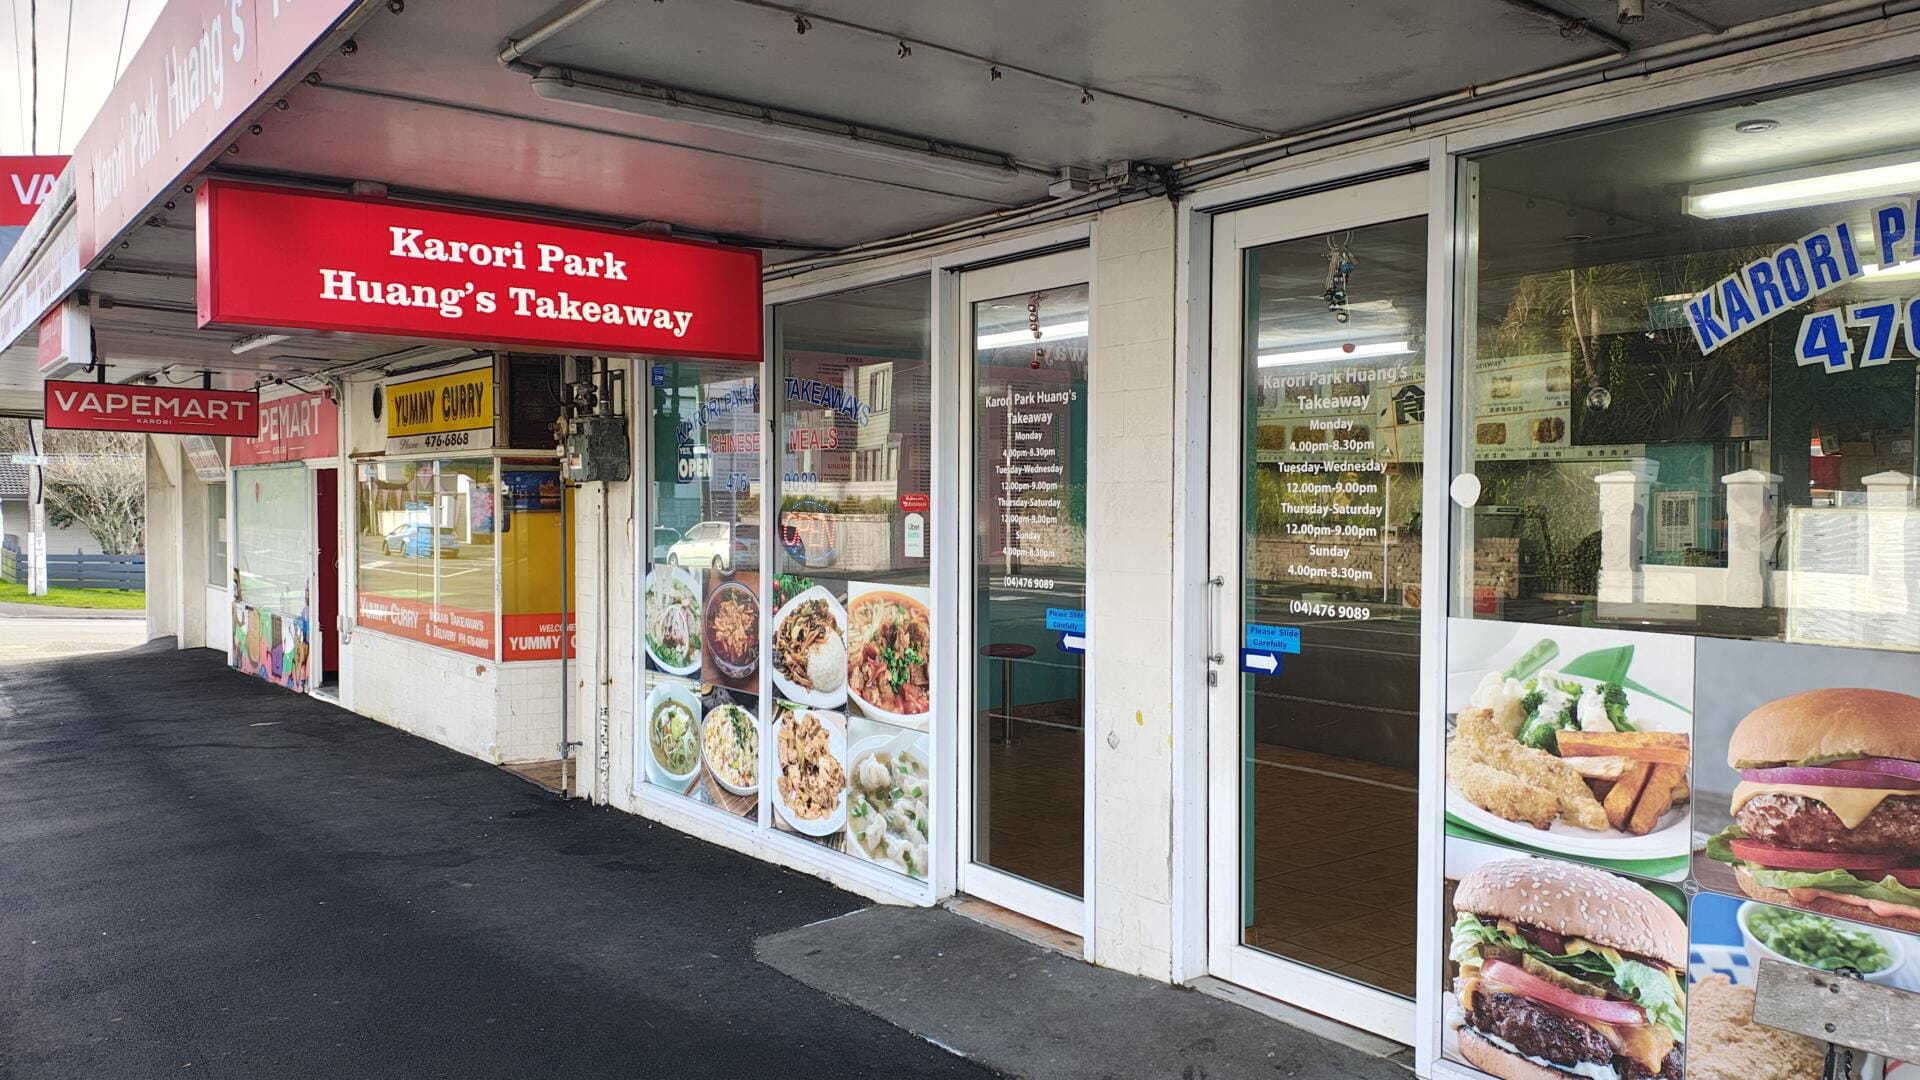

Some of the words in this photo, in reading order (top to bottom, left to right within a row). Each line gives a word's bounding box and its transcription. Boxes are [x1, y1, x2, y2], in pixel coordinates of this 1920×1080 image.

[93, 116, 127, 216] Karori
[129, 77, 161, 177] Park
[389, 226, 525, 271] Karori
[537, 243, 628, 281] Park
[1687, 222, 1861, 353] KARORI
[319, 269, 497, 318] Huang's
[509, 287, 693, 338] Takeaway
[1263, 373, 1306, 389] Karori
[1309, 368, 1342, 387] Park
[1345, 364, 1408, 384] Huang's
[54, 389, 250, 421] VAPEMART
[394, 389, 435, 427] YUMMY
[442, 382, 484, 422] CURRY
[985, 393, 1011, 408] Karori
[1014, 392, 1035, 406] Park
[1036, 388, 1077, 406] Huang's
[1297, 394, 1371, 411] Takeaway
[675, 397, 721, 444] KARORI
[722, 382, 759, 411] PARK
[784, 376, 871, 428] TAKEAWAYS
[136, 417, 172, 425] KARORI
[1006, 412, 1053, 425] Takeaway
[1309, 419, 1354, 432] Monday
[711, 432, 760, 454] CHINESE
[789, 426, 839, 452] MEALS
[1014, 431, 1042, 442] Monday
[1002, 448, 1056, 460] 4.00pm-8.30pm
[1289, 440, 1375, 454] 4.00pm-8.30pm
[679, 458, 711, 478] OPEN
[995, 464, 1064, 476] Tuesday-Wednesday
[1277, 461, 1388, 474] Tuesday-Wednesday
[784, 471, 817, 492] 9089
[1001, 481, 1058, 492] 12.00pm-9.00pm
[1285, 481, 1378, 494] 12.00pm-9.00pm
[997, 497, 1061, 509] Thursday-Saturday
[1280, 502, 1383, 516] Thursday-Saturday
[1001, 514, 1058, 526] 12.00pm-9.00pm
[783, 513, 836, 547] OPEN
[1015, 531, 1041, 542] Sunday
[1285, 524, 1377, 537] 12.00pm-9.00pm
[1002, 547, 1056, 558] 4.00pm-8.30pm
[1309, 545, 1350, 559] Sunday
[1287, 565, 1373, 580] 4.00pm-8.30pm
[1032, 578, 1054, 590] 9089
[390, 602, 418, 629] CURRY
[1048, 610, 1067, 619] Please
[1288, 599, 1336, 619] (04)476
[1337, 604, 1370, 620] 9089
[449, 612, 484, 632] TAKEAWAYS
[1052, 622, 1078, 631] Carefully
[425, 623, 431, 636] &
[433, 625, 456, 642] DELIVERY
[458, 633, 466, 645] PH
[1250, 626, 1275, 637] Please
[1278, 628, 1299, 638] Slide
[508, 635, 561, 651] YUMMY
[1252, 638, 1287, 650] Carefully
